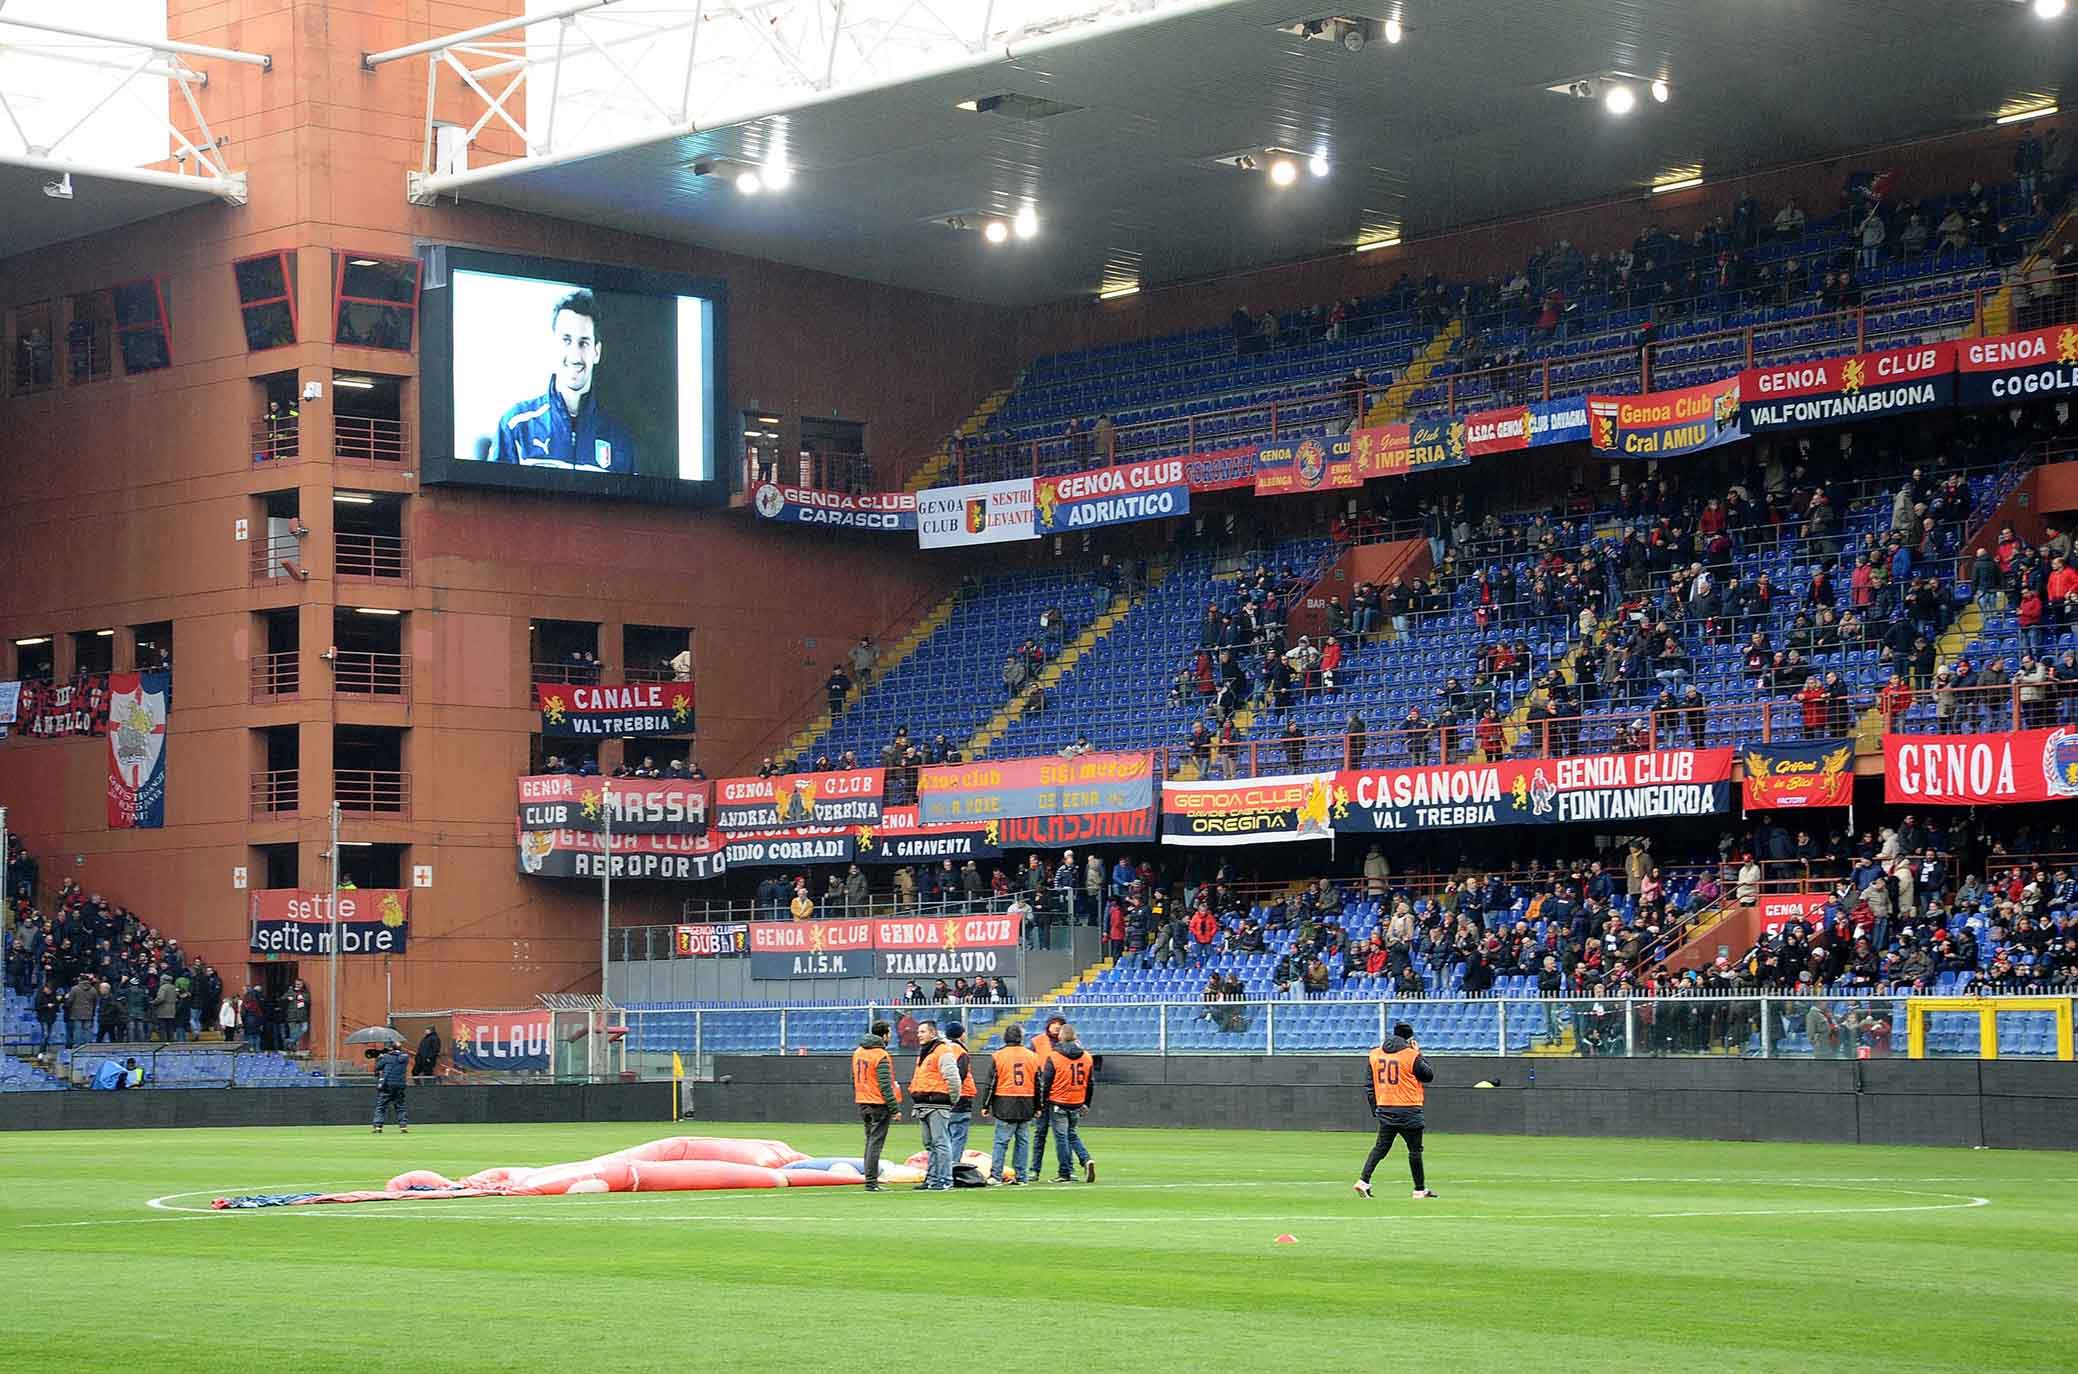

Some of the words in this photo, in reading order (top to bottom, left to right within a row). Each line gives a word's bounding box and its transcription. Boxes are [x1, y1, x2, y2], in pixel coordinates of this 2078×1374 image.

[1970, 337, 2047, 363] GENOA
[1759, 368, 1827, 392] GENOA
[1878, 350, 1936, 377] CLUB
[1620, 404, 1670, 424] Genoa
[1675, 394, 1712, 418] Club
[1750, 384, 1936, 425] VALFONTANABUONA
[1414, 427, 1440, 444] Club
[1625, 433, 1658, 453] Cral
[1662, 425, 1706, 449] AMIU
[1260, 448, 1292, 462] GENOA
[1332, 442, 1350, 455] CLU
[1376, 445, 1446, 469] IMPERIA
[1057, 470, 1125, 499] GENOA
[1130, 461, 1182, 489] CLUB
[784, 489, 856, 508] GENOA
[858, 494, 916, 510] CLUB
[918, 499, 964, 514] GENOA
[992, 489, 1031, 506] SESTRI
[1067, 491, 1173, 526] ADRIATICO
[799, 508, 900, 528] CARASCO
[923, 519, 958, 534] CLUB
[1307, 599, 1325, 608] BAR
[573, 687, 663, 709] CANALE
[32, 711, 91, 734] ANELLO
[1557, 756, 1625, 789] GENOA
[1634, 751, 1694, 784] CLUB
[1898, 742, 2016, 796] GENOA
[523, 780, 573, 797] GENOA
[725, 782, 773, 799] GENOA
[825, 777, 873, 794] CLUB
[1175, 793, 1243, 807] GENOA
[1245, 789, 1302, 804] CLUB
[1357, 768, 1501, 808] CASANOVA
[526, 805, 568, 824] CLUB
[606, 791, 705, 823] MASSA
[1558, 784, 1715, 821] FONTANIGORDA
[718, 809, 777, 827] ANDREA
[1192, 815, 1286, 832] OREGINA
[1373, 811, 1407, 829] VAL
[1415, 805, 1496, 827] TREBBIA
[768, 840, 844, 859] CORRADI
[897, 838, 971, 856] GARAVENTA
[575, 851, 727, 878] AEROPORTO
[287, 893, 356, 920] sette
[756, 928, 805, 946] GENOA
[828, 924, 868, 944] CLUB
[880, 923, 938, 943] GENOA
[964, 919, 1011, 941] CLUB
[690, 934, 735, 953] DUBAI
[793, 955, 847, 974] A.I.S.M.
[885, 951, 997, 973] PIAMPALUDO
[1014, 1063, 1024, 1086] 6
[1070, 1063, 1085, 1086] 16
[1377, 1058, 1399, 1086] 20
